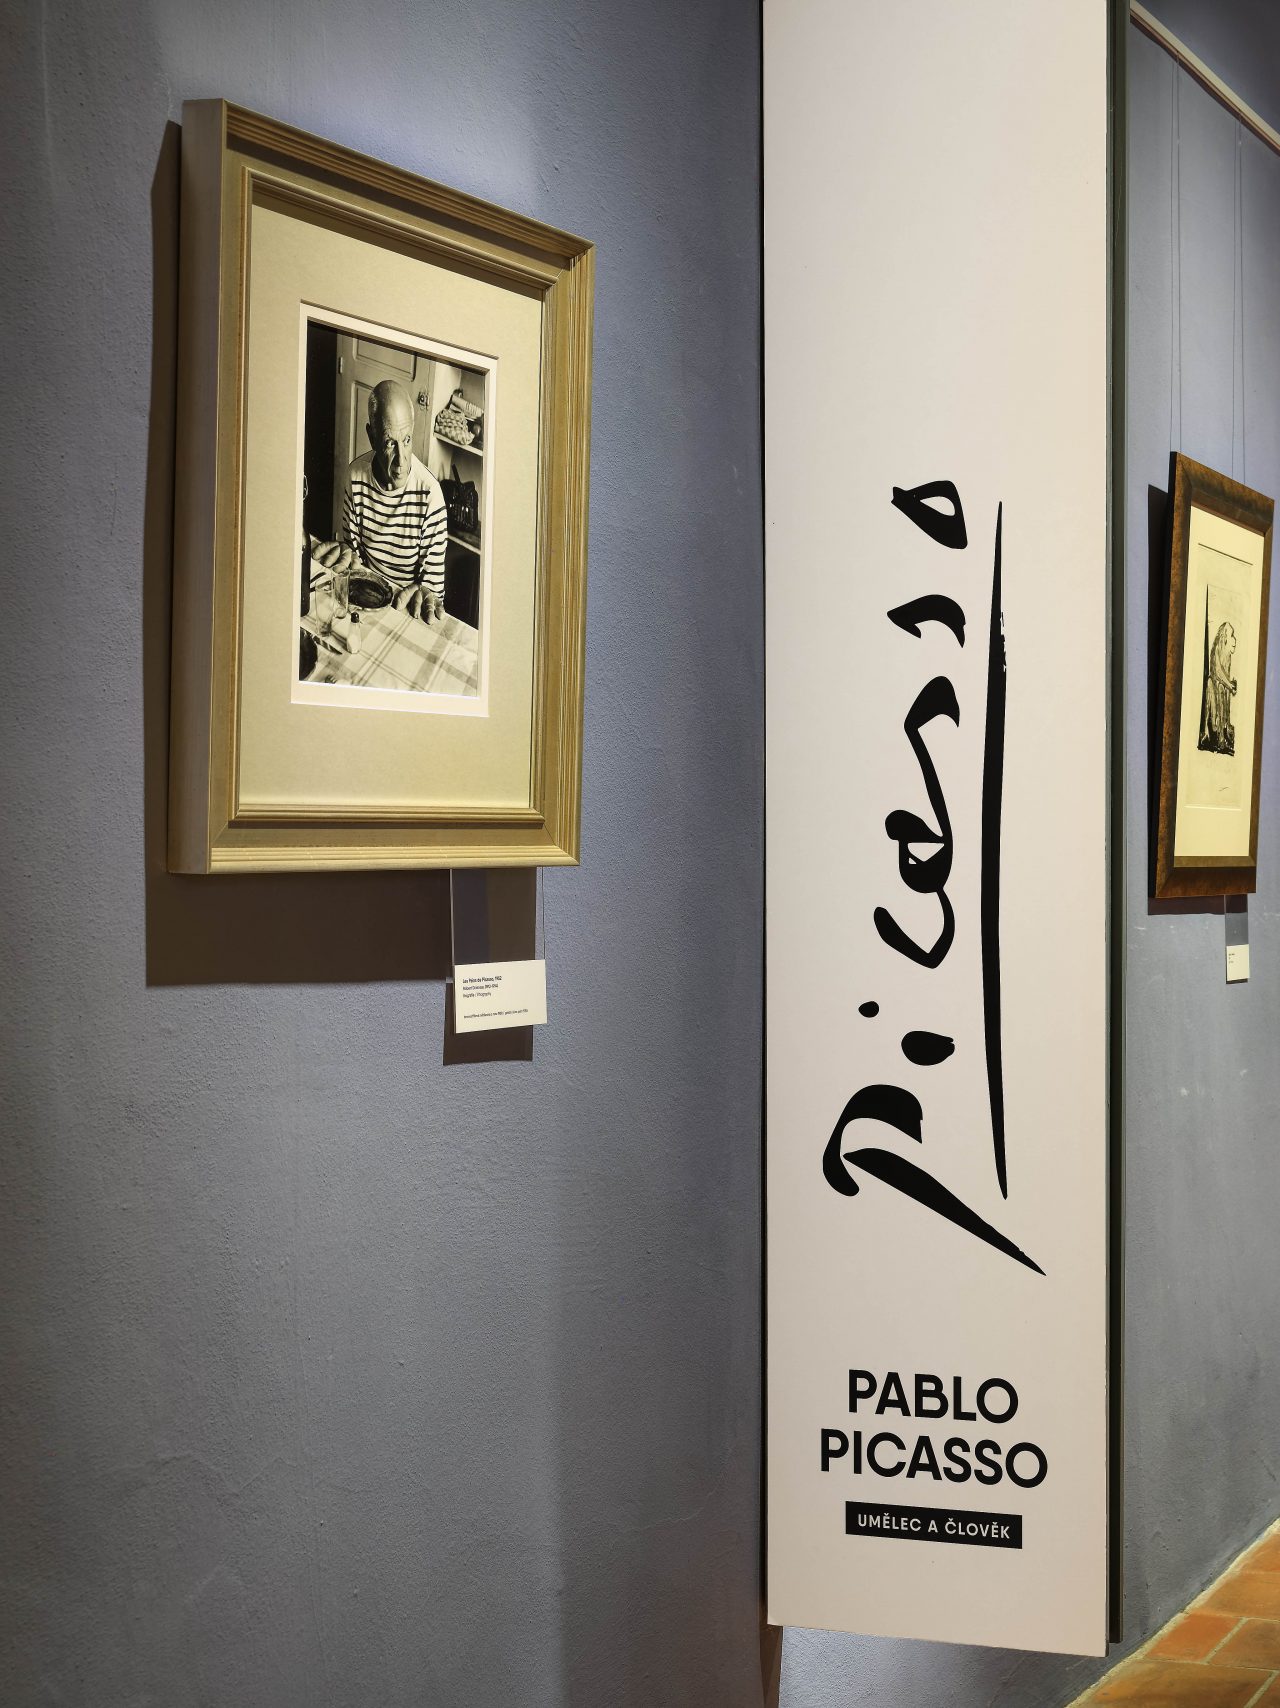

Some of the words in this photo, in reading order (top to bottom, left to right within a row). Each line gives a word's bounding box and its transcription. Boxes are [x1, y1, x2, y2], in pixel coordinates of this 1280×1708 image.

[848, 1369, 1019, 1424] PABLO
[820, 1428, 1048, 1489] PICASSO
[857, 1512, 922, 1532] UMĚLEC
[927, 1519, 939, 1533] A
[944, 1517, 1010, 1539] ČLOVĚK
